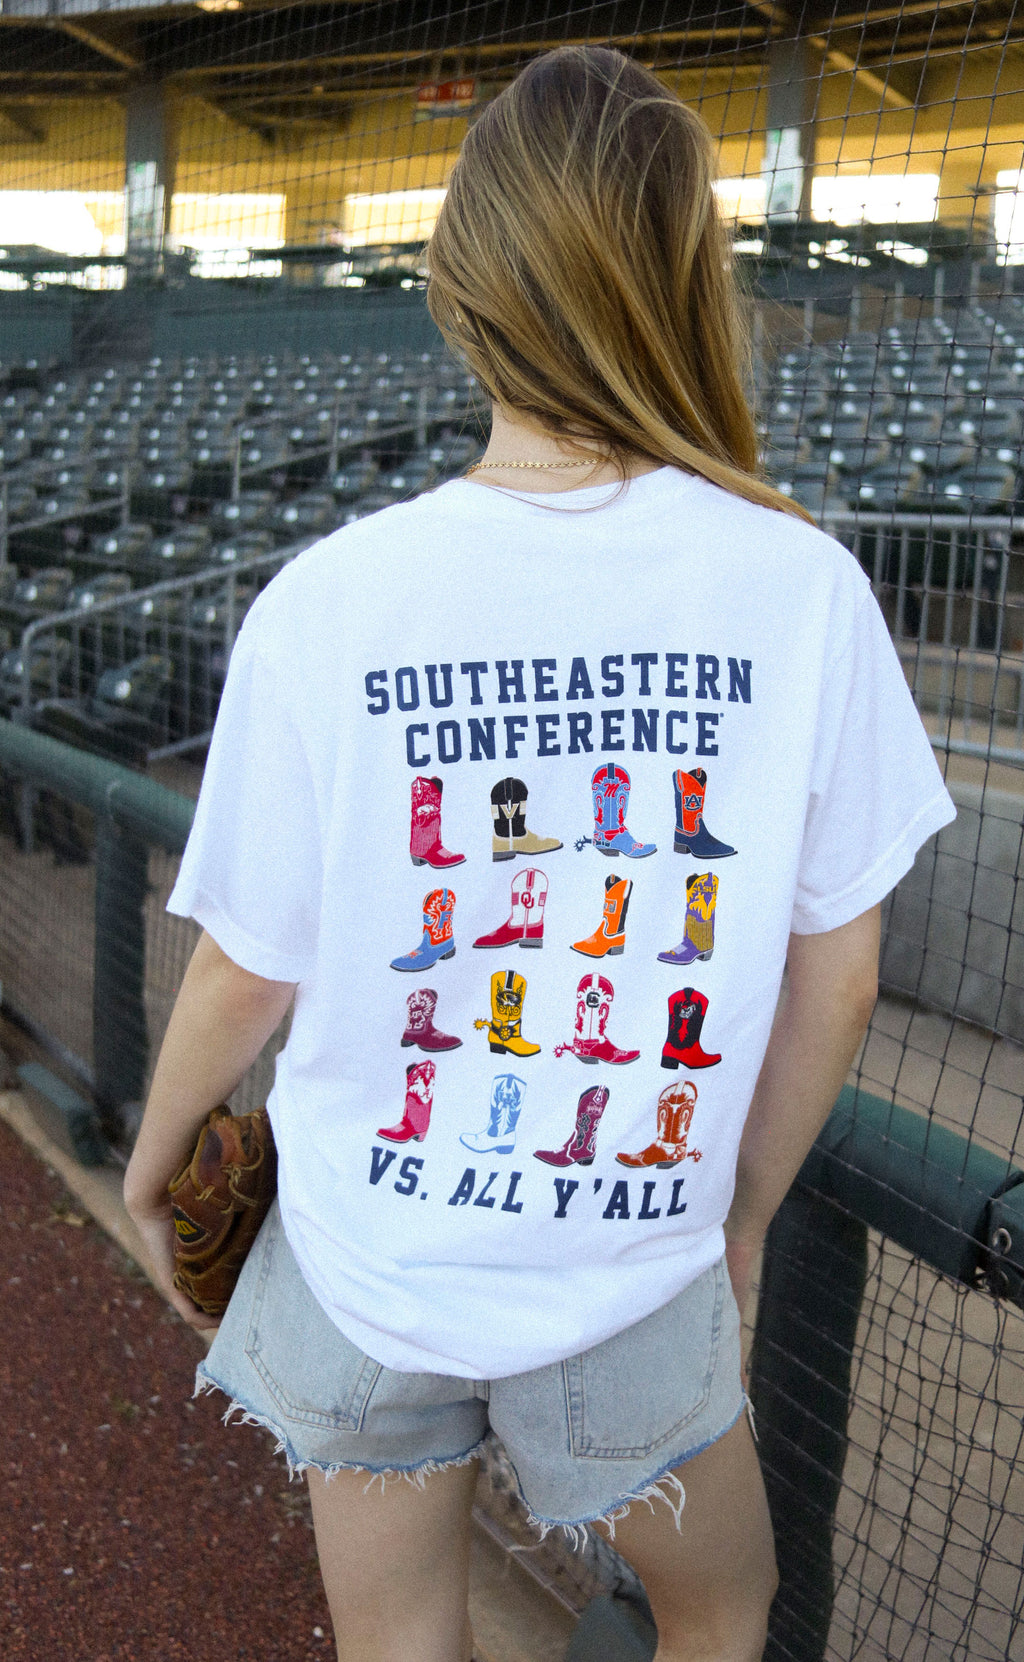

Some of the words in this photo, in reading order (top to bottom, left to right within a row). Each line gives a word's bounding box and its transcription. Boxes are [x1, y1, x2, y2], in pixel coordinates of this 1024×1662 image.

[365, 653, 752, 715] SOUTHEASTERN
[368, 1147, 428, 1201] VS.
[448, 1168, 523, 1213] ALL
[554, 1178, 688, 1219] Y'ALL
